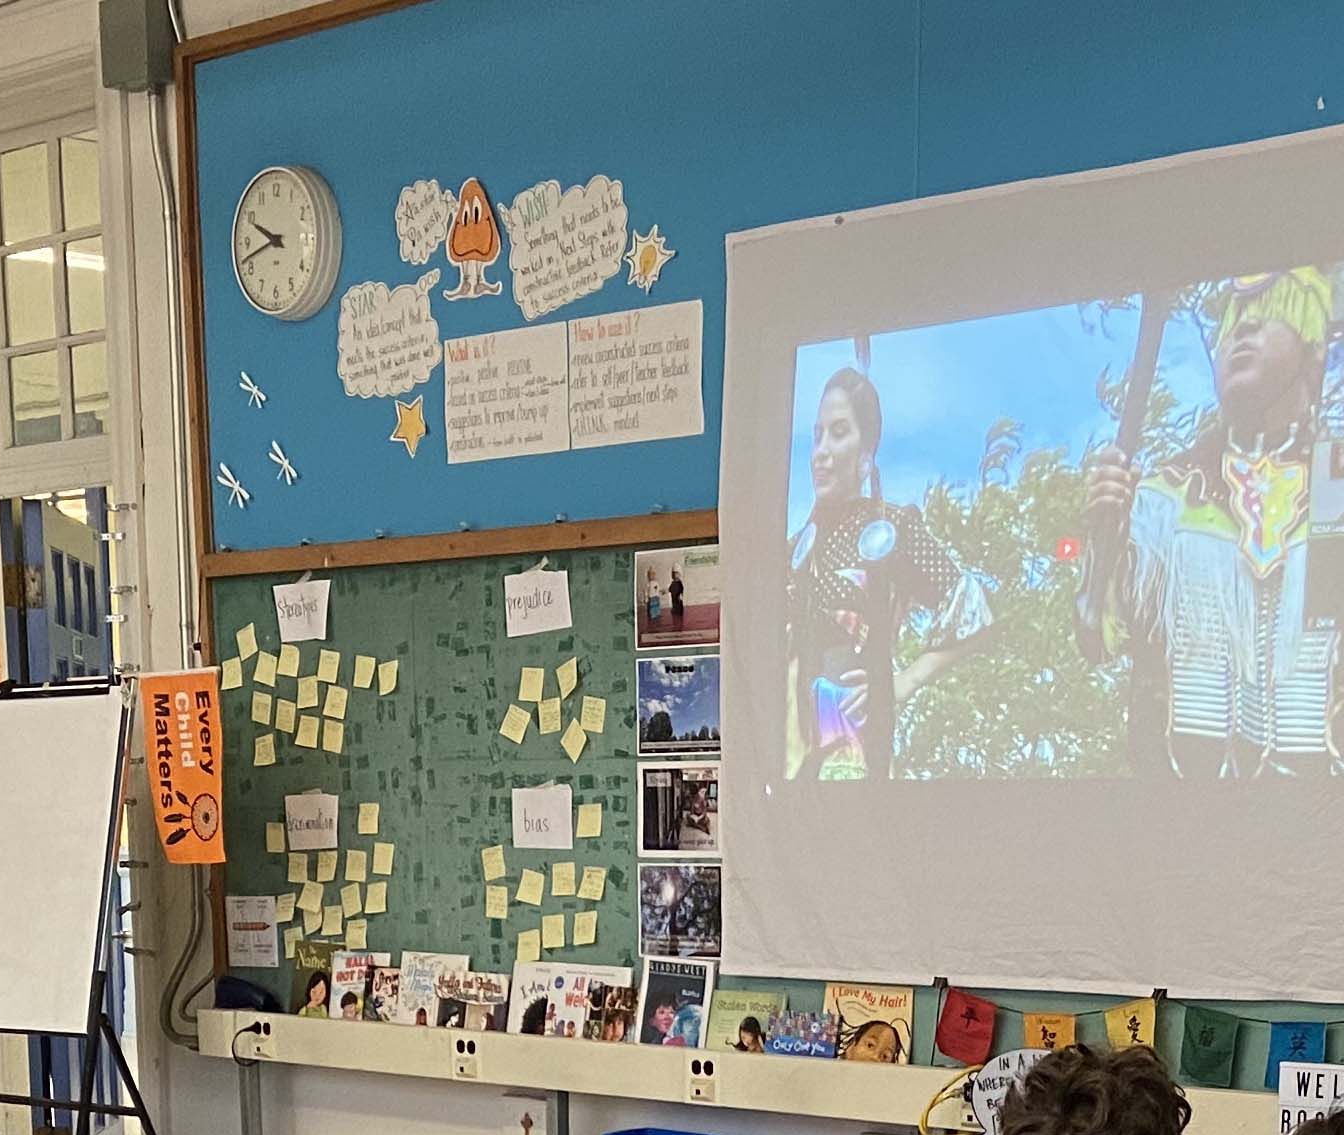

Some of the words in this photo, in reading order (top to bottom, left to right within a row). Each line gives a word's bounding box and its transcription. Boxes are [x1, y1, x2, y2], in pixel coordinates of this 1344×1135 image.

[519, 193, 548, 229] WISH
[350, 291, 377, 320] STAR
[507, 589, 554, 623] prejudice
[175, 692, 195, 768] Child
[195, 690, 214, 776] Every
[153, 693, 173, 809] Matters
[524, 807, 550, 833] bias
[296, 948, 326, 971] Name
[336, 970, 355, 982] HOT
[573, 976, 585, 991] All
[565, 992, 588, 1008] Welc
[717, 1000, 747, 1011] Stolen
[832, 987, 836, 998] I
[838, 986, 860, 998] Love
[862, 990, 876, 1006] My
[879, 994, 907, 1008] Hair!
[773, 1040, 794, 1052] Only
[999, 1056, 1010, 1071] IN
[1018, 1053, 1026, 1070] A
